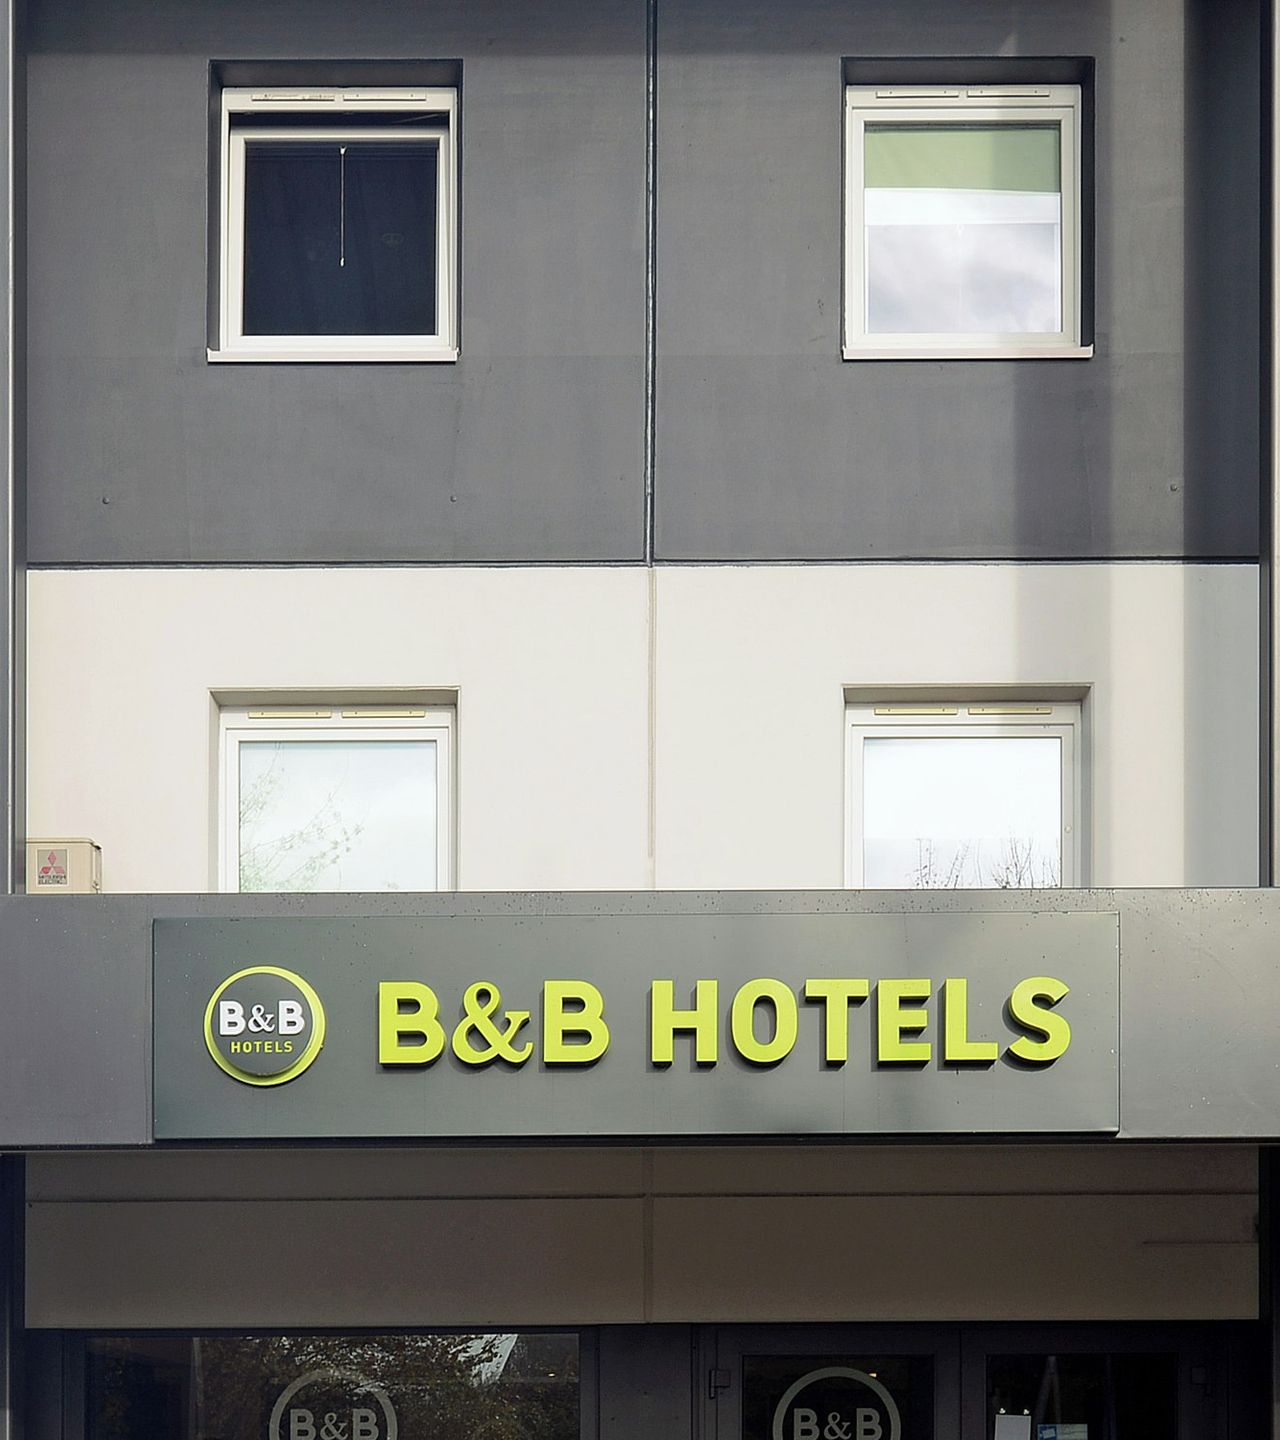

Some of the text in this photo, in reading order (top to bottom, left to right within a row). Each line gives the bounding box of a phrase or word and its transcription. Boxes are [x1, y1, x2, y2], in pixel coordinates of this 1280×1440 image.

[219, 1000, 306, 1036] B&B
[377, 975, 1072, 1066] B&B HOTELS
[230, 1041, 294, 1054] HOTELS
